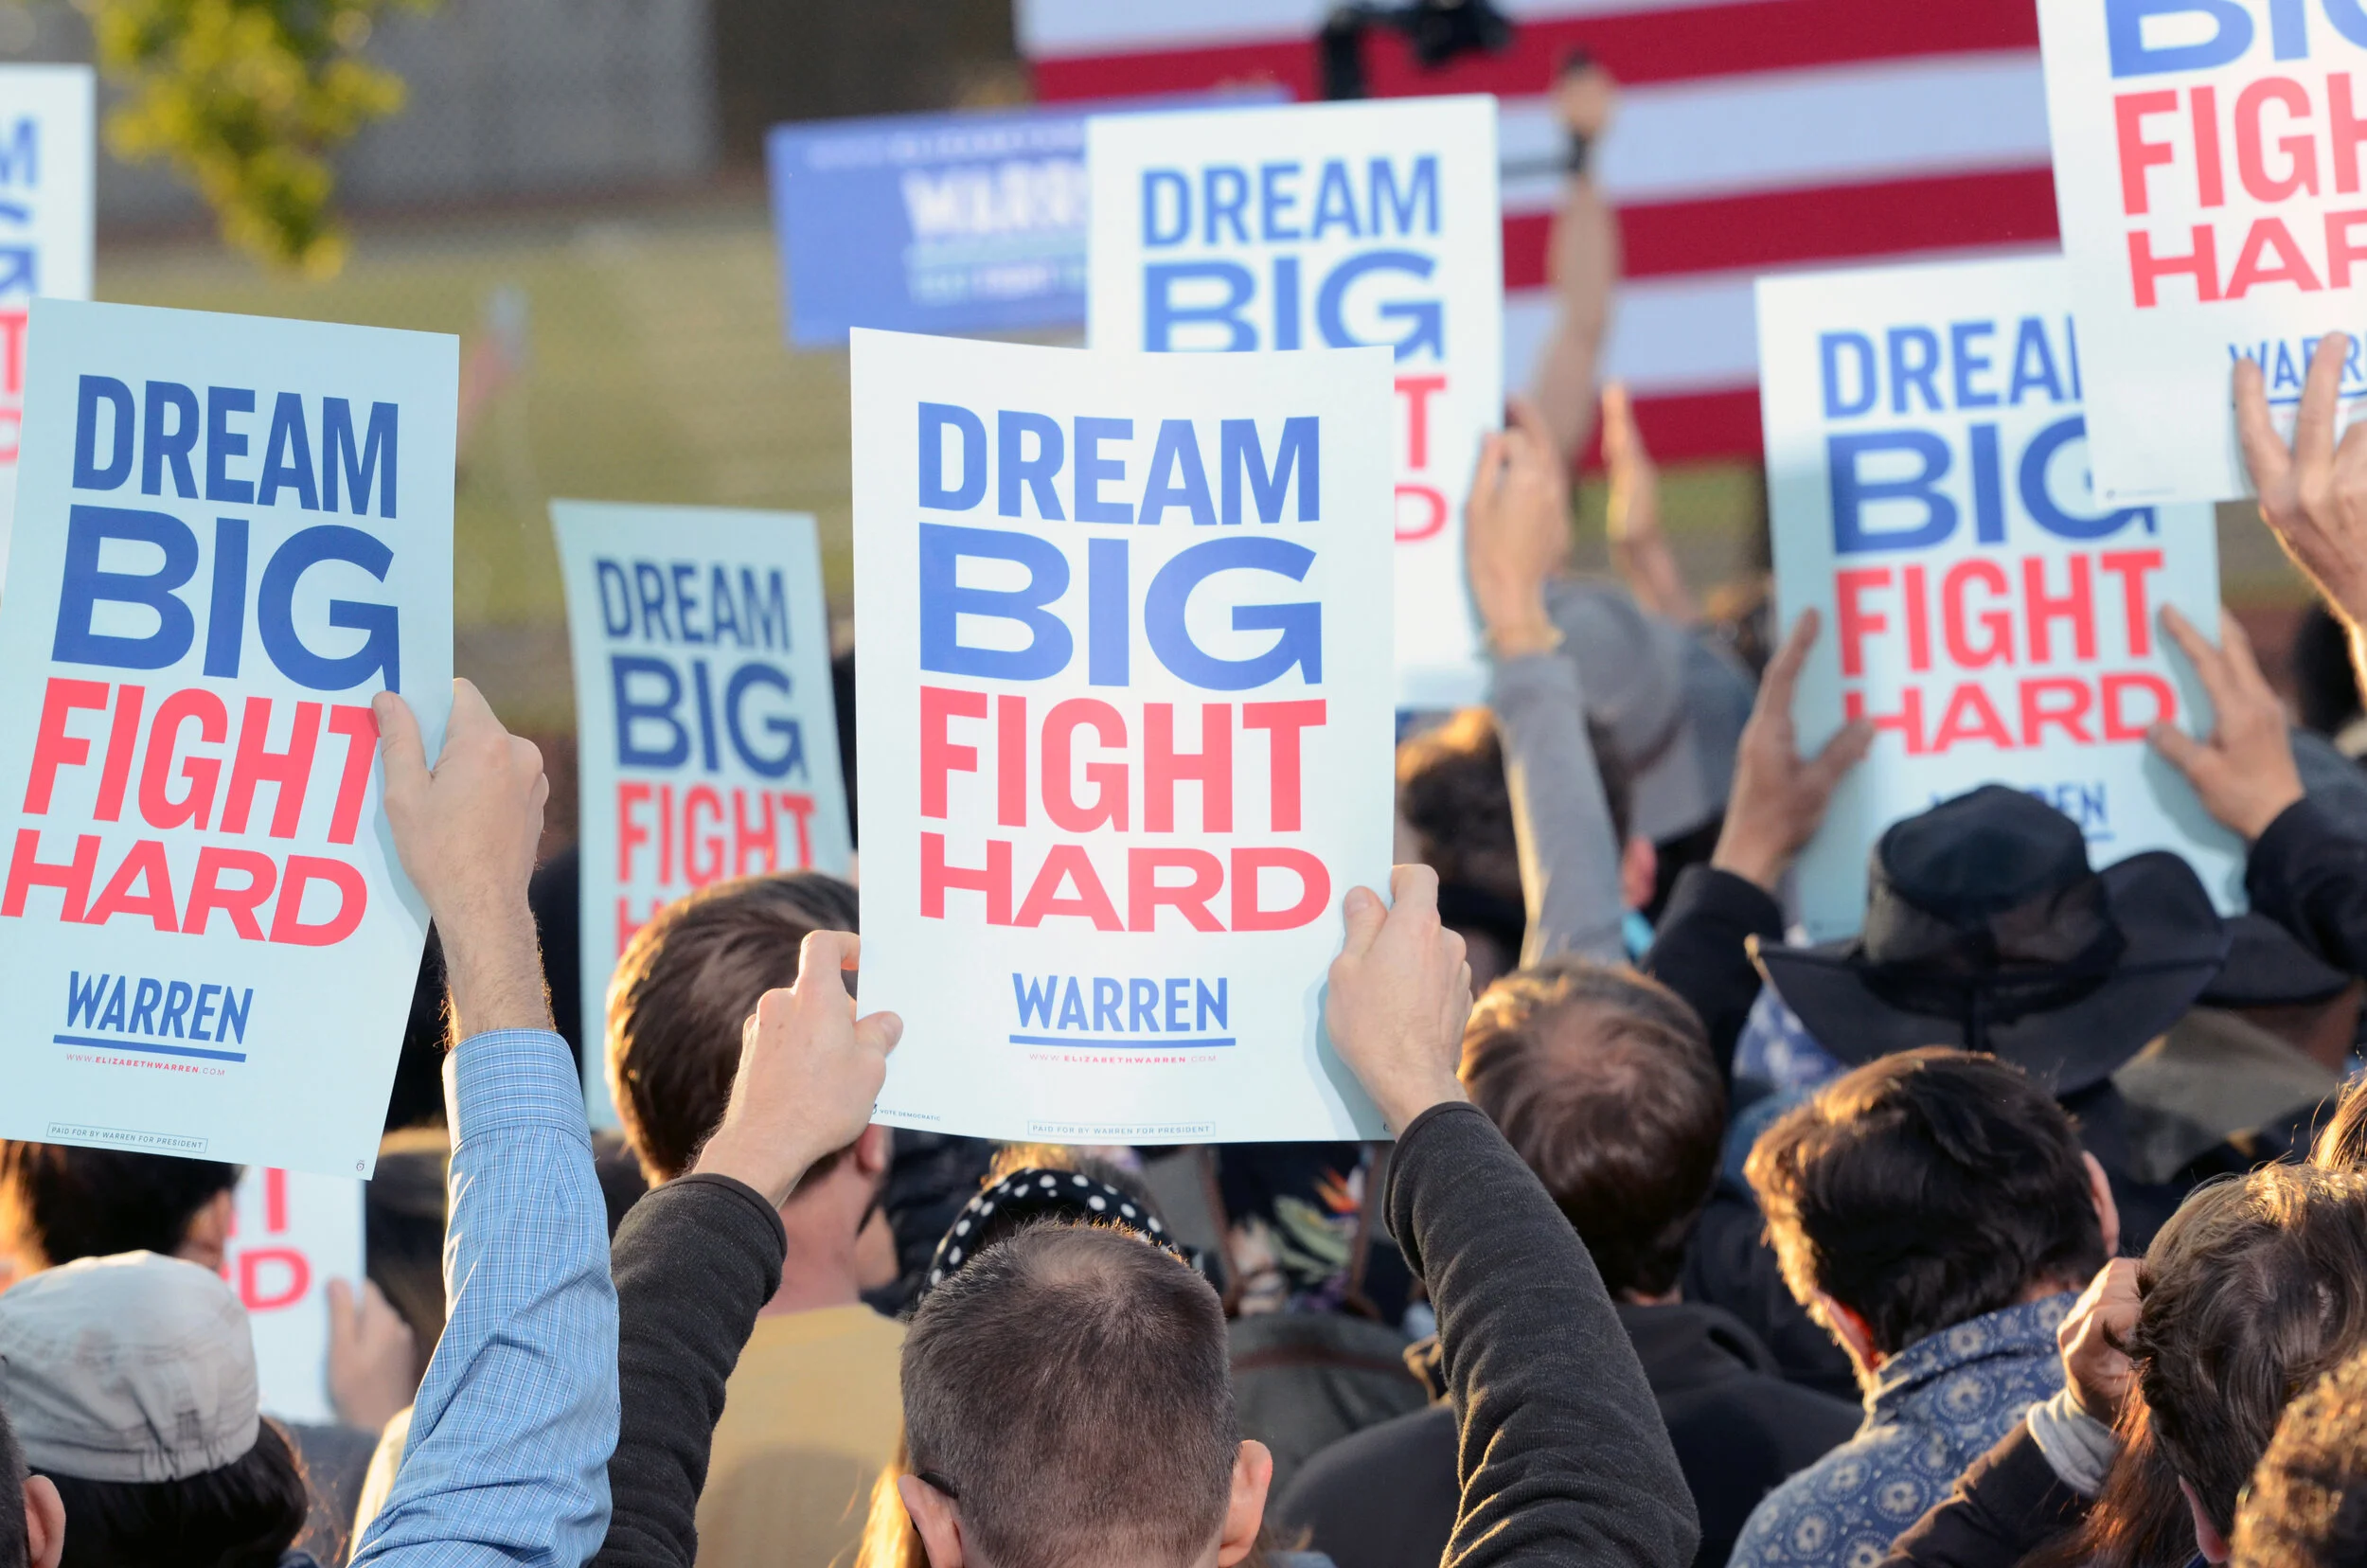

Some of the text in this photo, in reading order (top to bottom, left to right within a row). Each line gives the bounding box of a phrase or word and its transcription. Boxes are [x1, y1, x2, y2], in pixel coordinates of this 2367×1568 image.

[1141, 154, 1442, 248] DREAM
[1143, 248, 1445, 362] BIG
[1819, 315, 2082, 419] DREA
[71, 374, 400, 520] DREAM
[918, 401, 1321, 526] DREAM
[51, 503, 401, 695] BIG
[594, 558, 790, 650] DREAM
[919, 523, 1323, 691] BIG
[1836, 549, 2163, 677] FIGHT
[23, 677, 381, 846] FIGHT
[610, 654, 808, 781] BIG
[919, 686, 1327, 833] FIGHT
[1844, 673, 2178, 756] HARD
[0, 828, 367, 947] HARD
[614, 780, 816, 890] FIGHT
[919, 830, 1331, 933] HARD
[67, 971, 254, 1044] WARREN
[1012, 972, 1228, 1032] WARREN
[65, 1052, 226, 1077] WWW.ELIZABETHWARREN.COM
[899, 1111, 941, 1122] DEMOCRATIC
[51, 1127, 70, 1135] PAID
[72, 1129, 87, 1137] FOR
[102, 1131, 136, 1142] WARREN
[138, 1135, 154, 1144] FOR
[156, 1138, 204, 1149] PRESIDENT
[1032, 1124, 1211, 1135] PAID FOR BY WARREN FOR PRESIDENT
